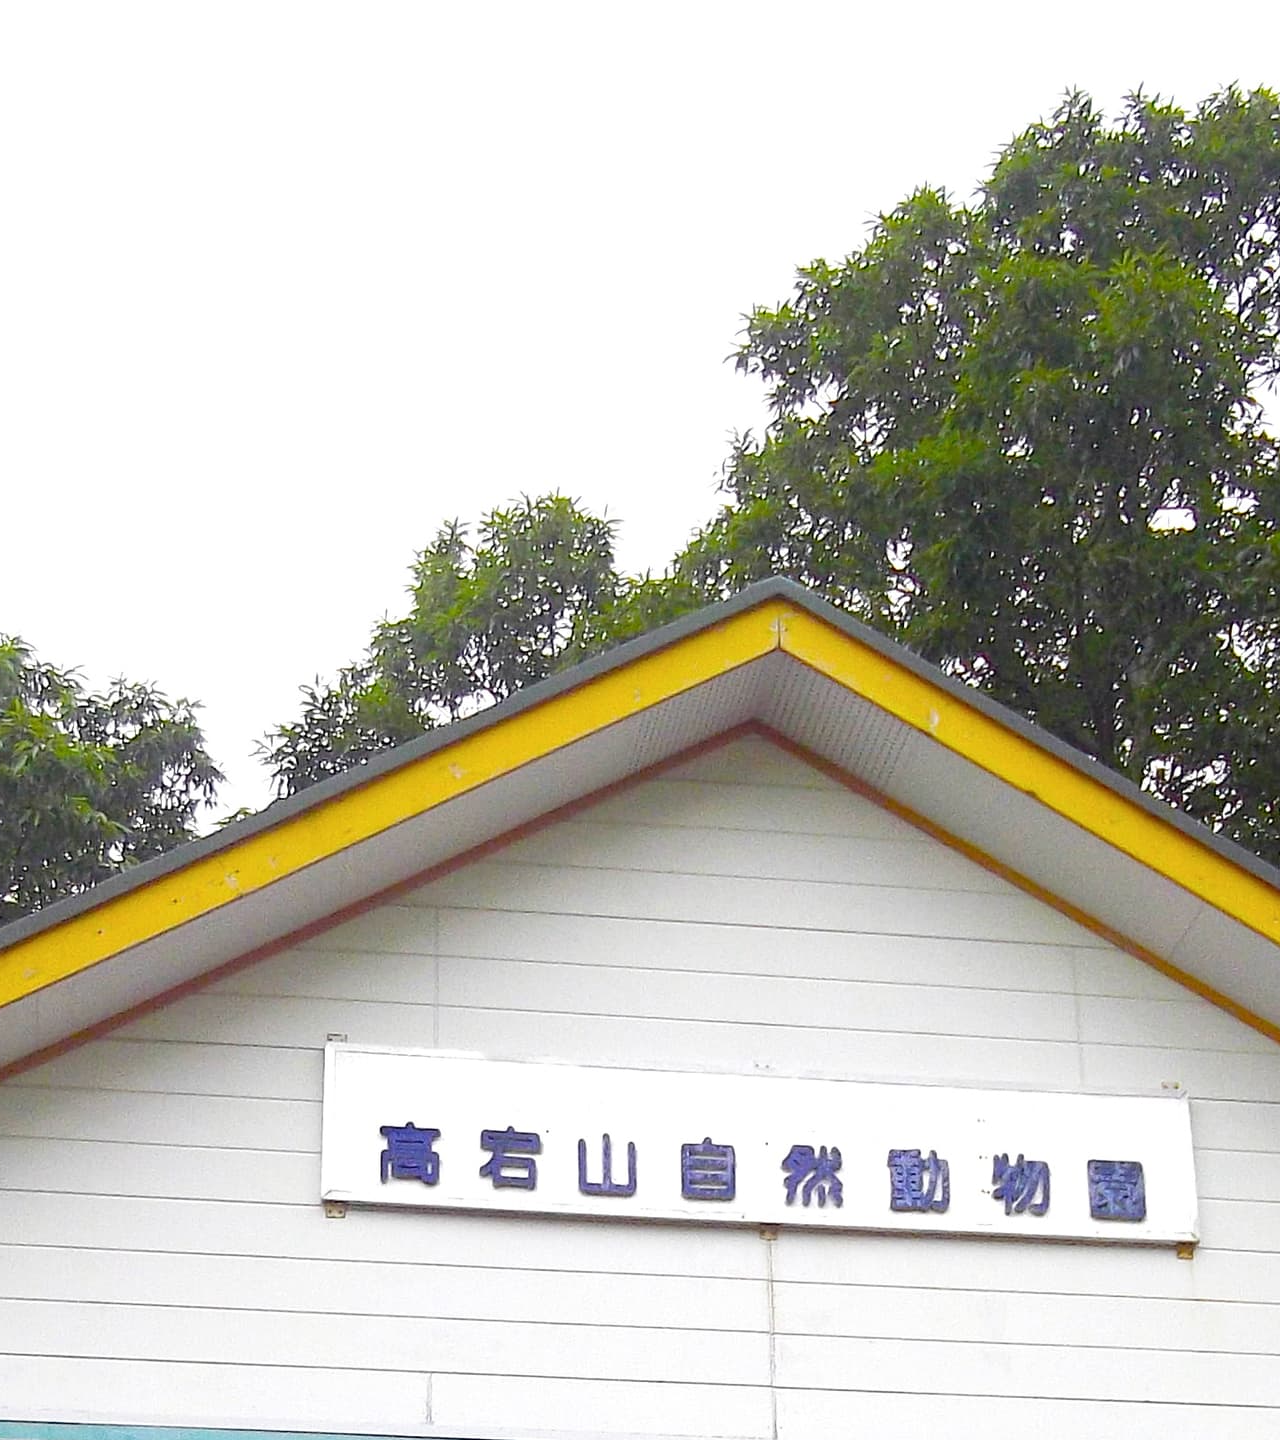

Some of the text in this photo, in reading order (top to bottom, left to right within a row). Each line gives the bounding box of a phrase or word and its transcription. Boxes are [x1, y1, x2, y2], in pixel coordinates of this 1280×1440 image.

[380, 1122, 1147, 1222] 高宕山自然動物園
